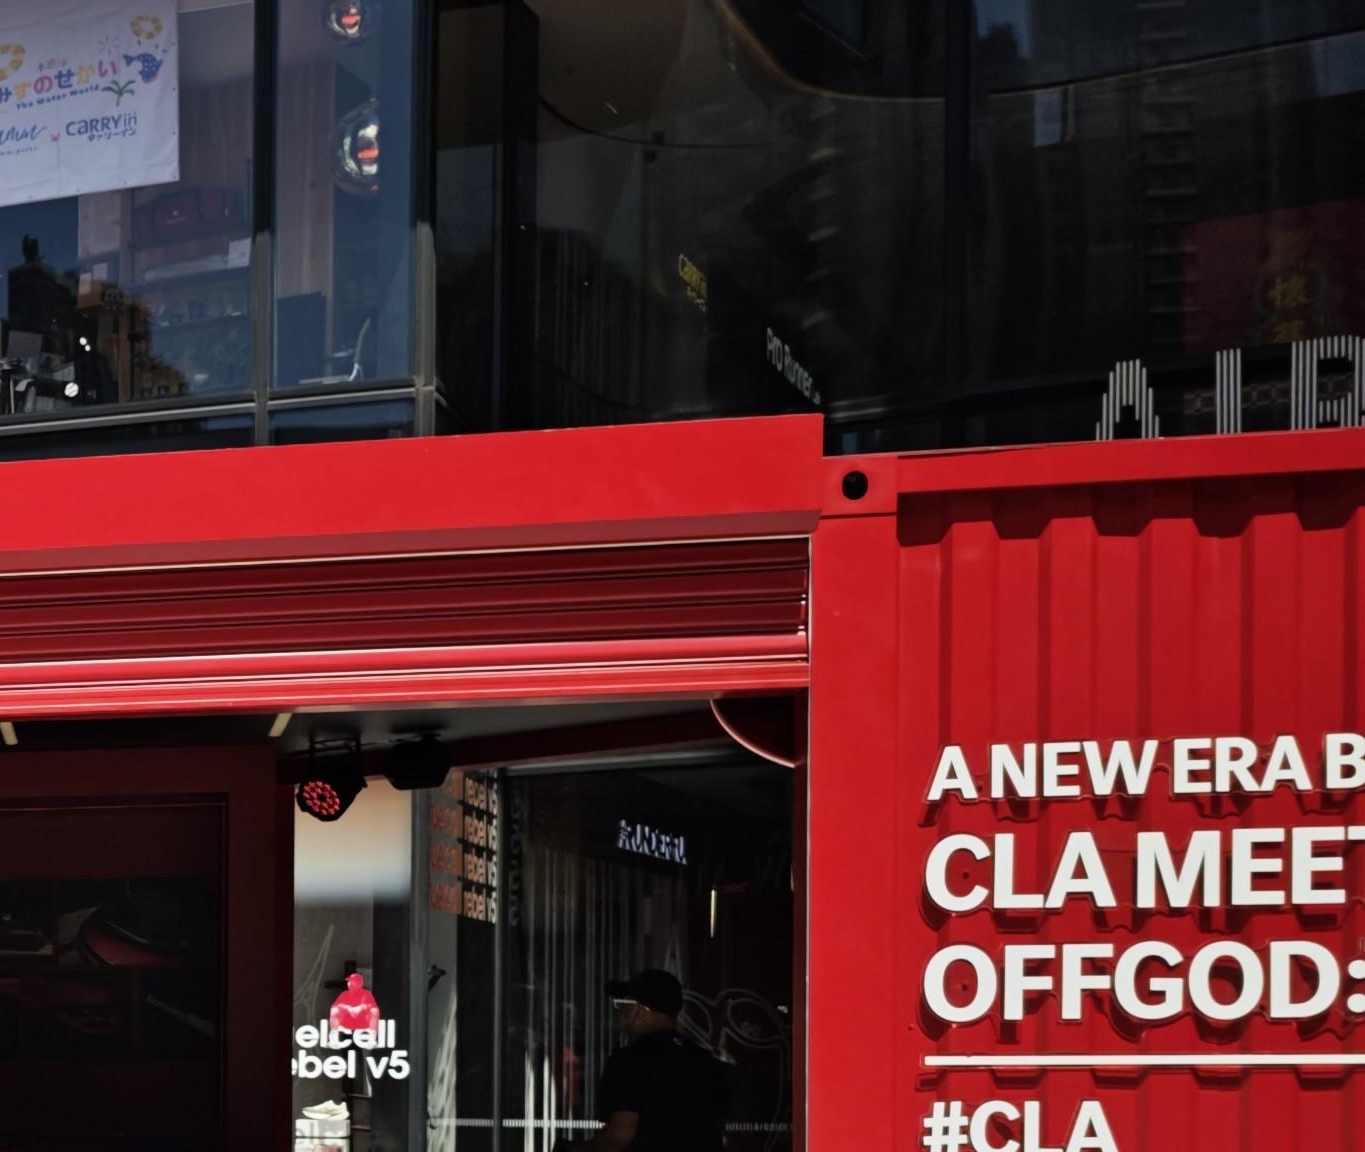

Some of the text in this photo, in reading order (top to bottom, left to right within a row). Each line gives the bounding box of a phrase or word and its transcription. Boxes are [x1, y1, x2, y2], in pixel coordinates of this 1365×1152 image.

[927, 745, 978, 800] A
[991, 740, 1158, 798] NEW
[1174, 735, 1312, 794] ERA
[925, 831, 1117, 912] CLA
[924, 940, 1365, 1022] OFFGOD:
[292, 1050, 411, 1080] bel v5
[293, 1019, 395, 1050] elcell
